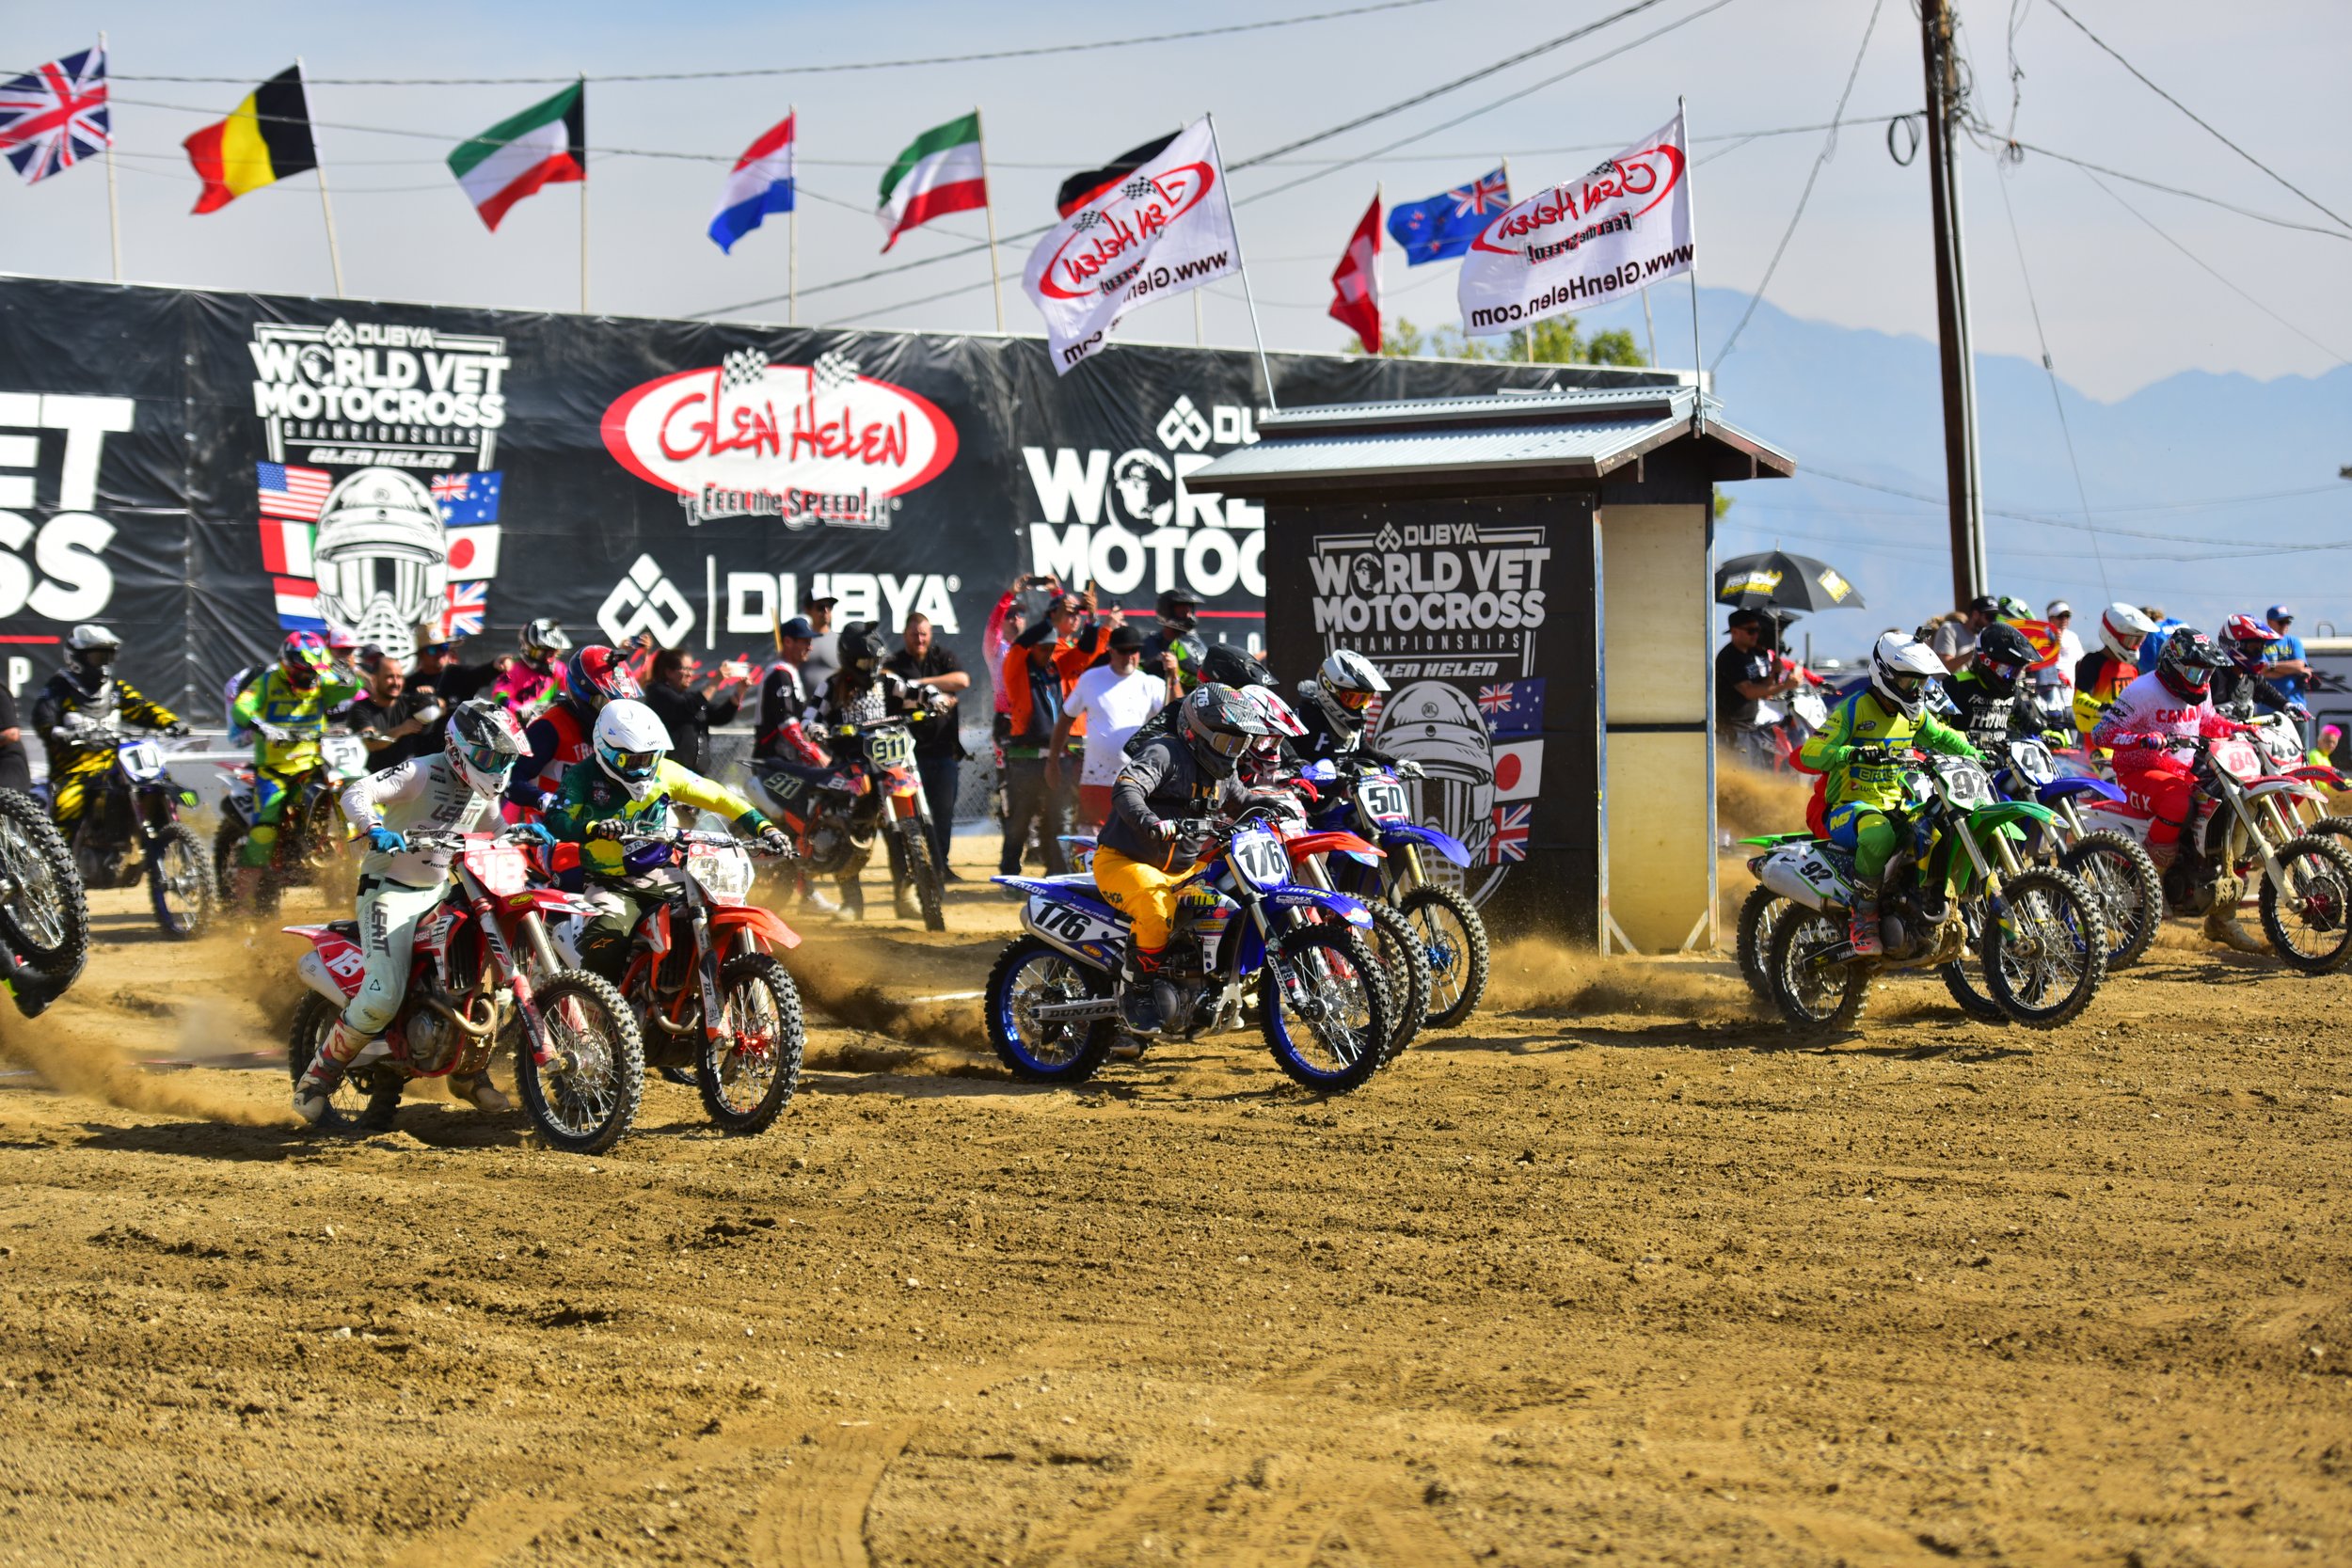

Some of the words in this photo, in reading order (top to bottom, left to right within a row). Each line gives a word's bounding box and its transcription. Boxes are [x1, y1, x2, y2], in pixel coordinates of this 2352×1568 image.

[356, 323, 437, 349] DUBYA
[248, 341, 421, 389] WORLD
[423, 352, 512, 394] VET
[252, 380, 507, 429] MOTOCROSS
[659, 367, 780, 461] GLEN
[791, 367, 908, 468] HELEN
[284, 420, 481, 446] CHAMPIONSHIPS
[308, 447, 375, 467] GLEN
[374, 451, 456, 469] HELEN
[702, 483, 751, 518] FEEL
[751, 488, 783, 515] the
[782, 485, 867, 521] SPEED!
[1404, 523, 1479, 546] DUBYA
[1308, 550, 1463, 599] WORLD
[1468, 547, 1550, 592] VET
[727, 572, 960, 634] DUBYA
[1312, 590, 1546, 633] MOTOCROSS
[1341, 633, 1520, 652] CHAMPIONSHIPS
[1374, 662, 1423, 678] LEN
[1422, 661, 1499, 678] HELEN
[872, 735, 907, 765] 911
[2229, 751, 2256, 772] 84
[763, 772, 803, 800] 911
[1369, 786, 1403, 815] 50
[483, 854, 526, 892] 18
[1239, 840, 1283, 879] 176
[1801, 861, 1834, 885] 92
[1005, 878, 1049, 895] DUNLOP
[1034, 901, 1092, 941] 176
[325, 948, 365, 978] 18
